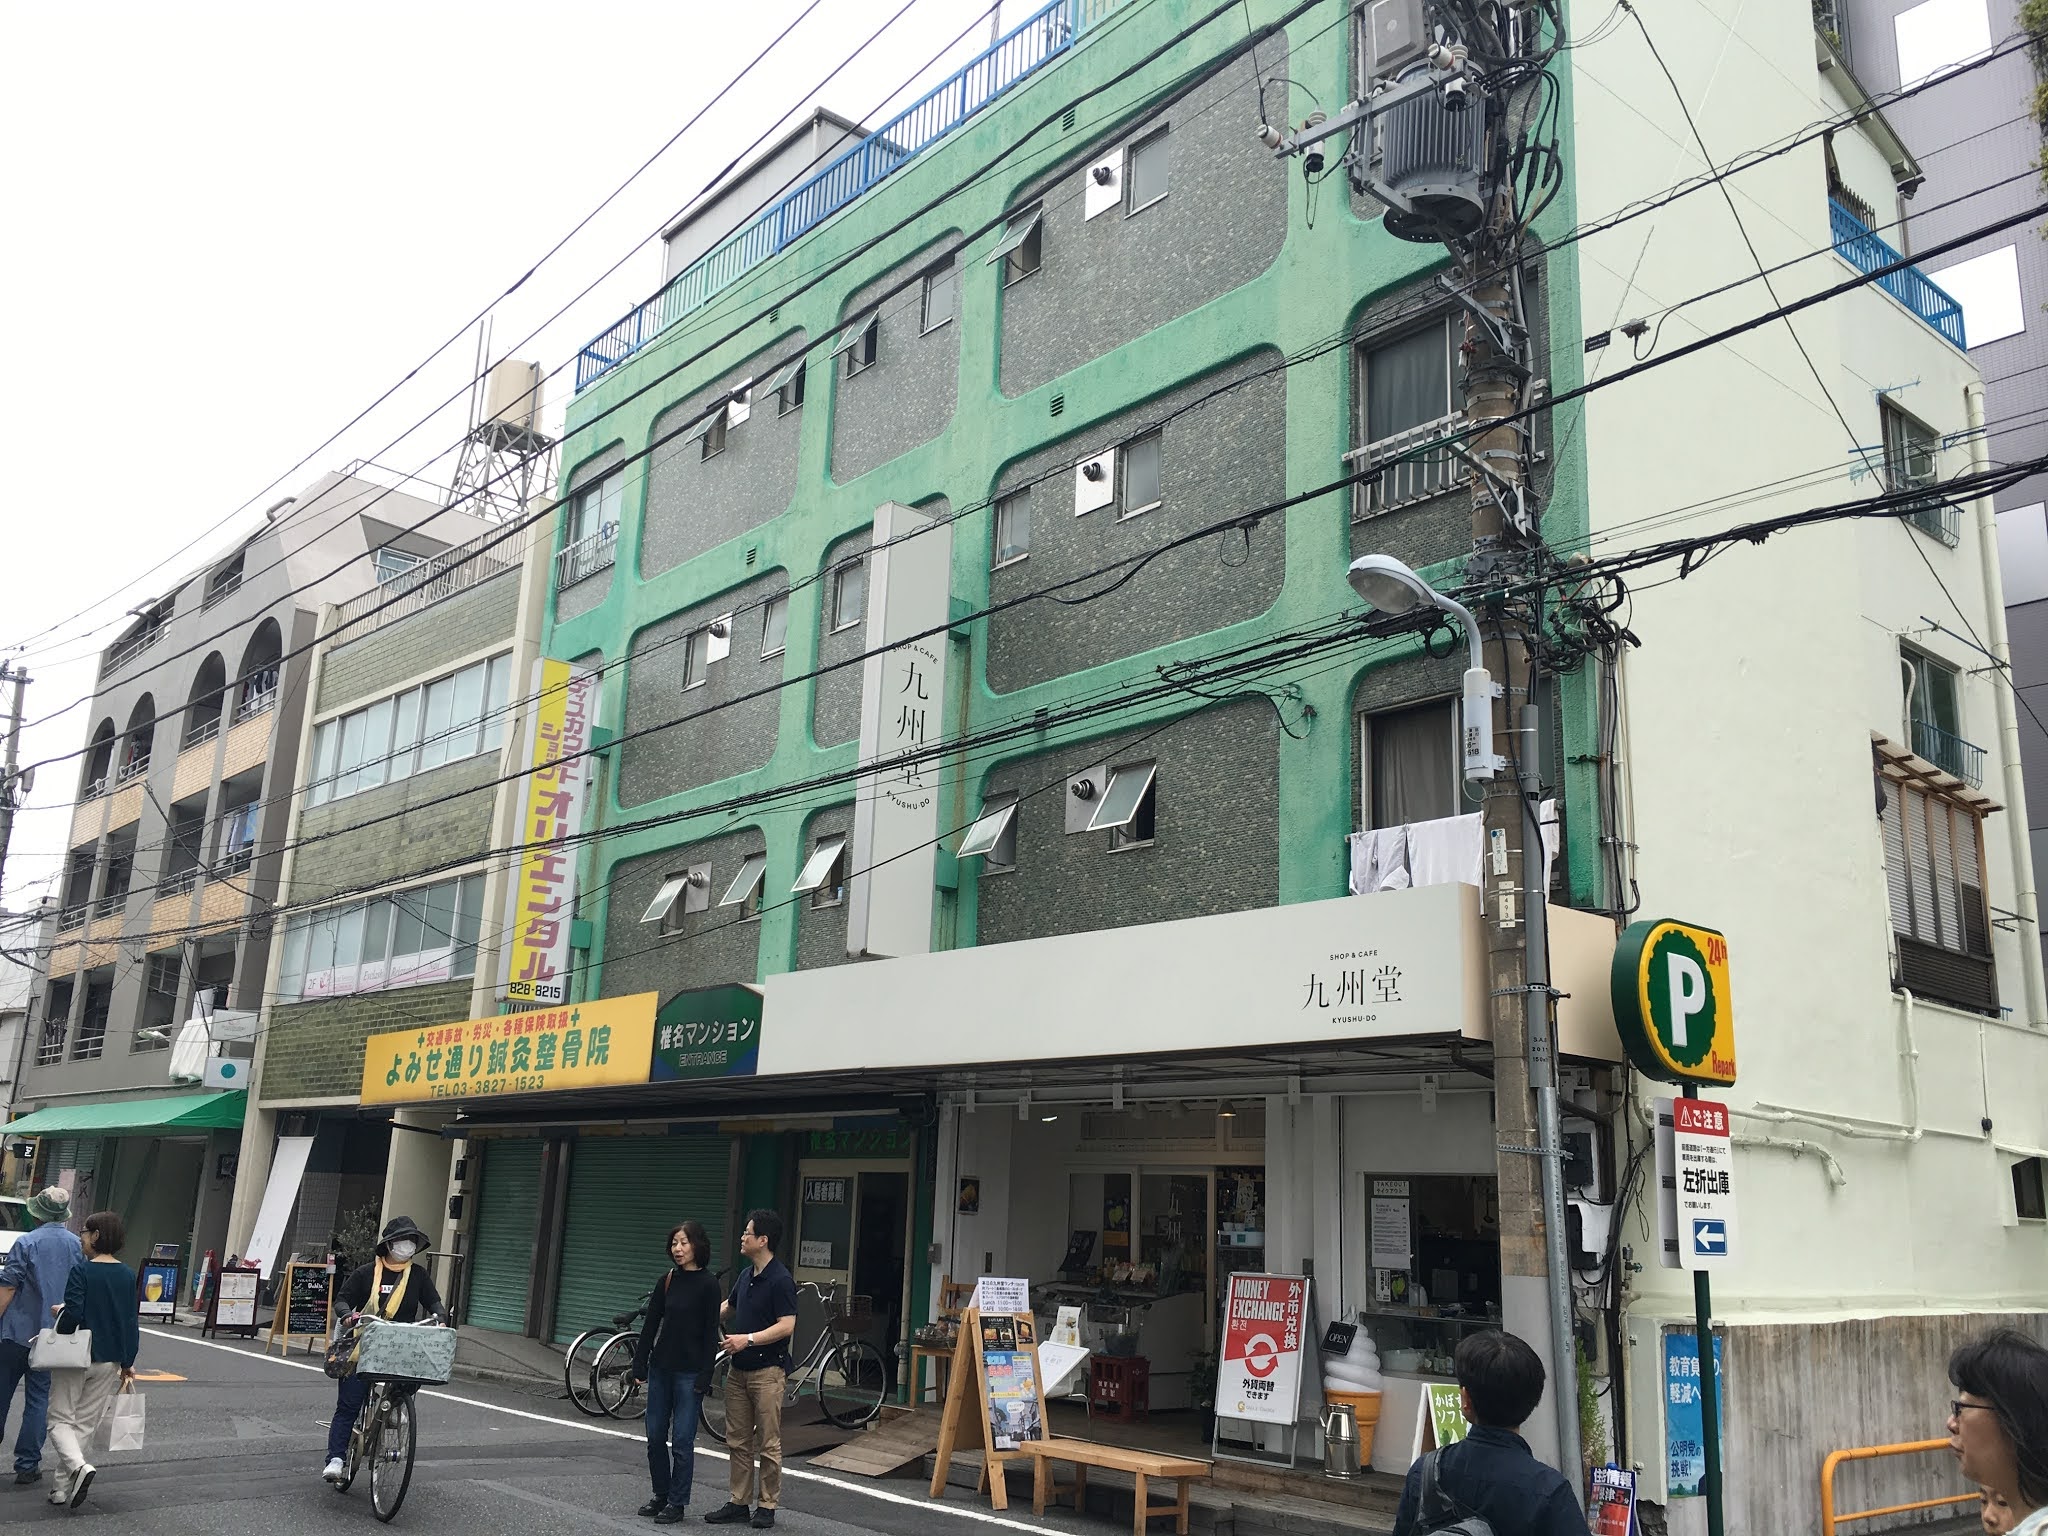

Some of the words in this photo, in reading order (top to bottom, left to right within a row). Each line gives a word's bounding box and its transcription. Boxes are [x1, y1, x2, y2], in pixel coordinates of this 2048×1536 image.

[919, 647, 939, 665] CAFE
[559, 676, 594, 785] ディスカウント
[519, 789, 574, 982] オリエンタル
[1329, 952, 1350, 961] SHOP
[1351, 951, 1356, 959] &
[1358, 950, 1378, 958] CAFE
[1707, 936, 1728, 967] 24h
[509, 981, 561, 999] 828-8215
[1301, 965, 1403, 1011] 九州堂
[1666, 951, 1706, 1048] P
[660, 1017, 755, 1050] 椎名マンション
[386, 1024, 612, 1086] よみせ通り鍼灸整骨院
[679, 1049, 728, 1067] ENTRANCE
[1711, 1049, 1737, 1078] Repark
[1692, 1109, 1724, 1131] ご注意
[1682, 1167, 1730, 1195] 左折出庫
[1234, 1279, 1270, 1300] MONEY
[1231, 1299, 1285, 1322] EXCHANGE
[1329, 1333, 1350, 1344] OPEN
[1242, 1378, 1275, 1392] 外貨両替
[1245, 1391, 1270, 1400] できます
[1669, 1382, 1702, 1404] 軽減へ
[1670, 1440, 1702, 1458] 公明党の
